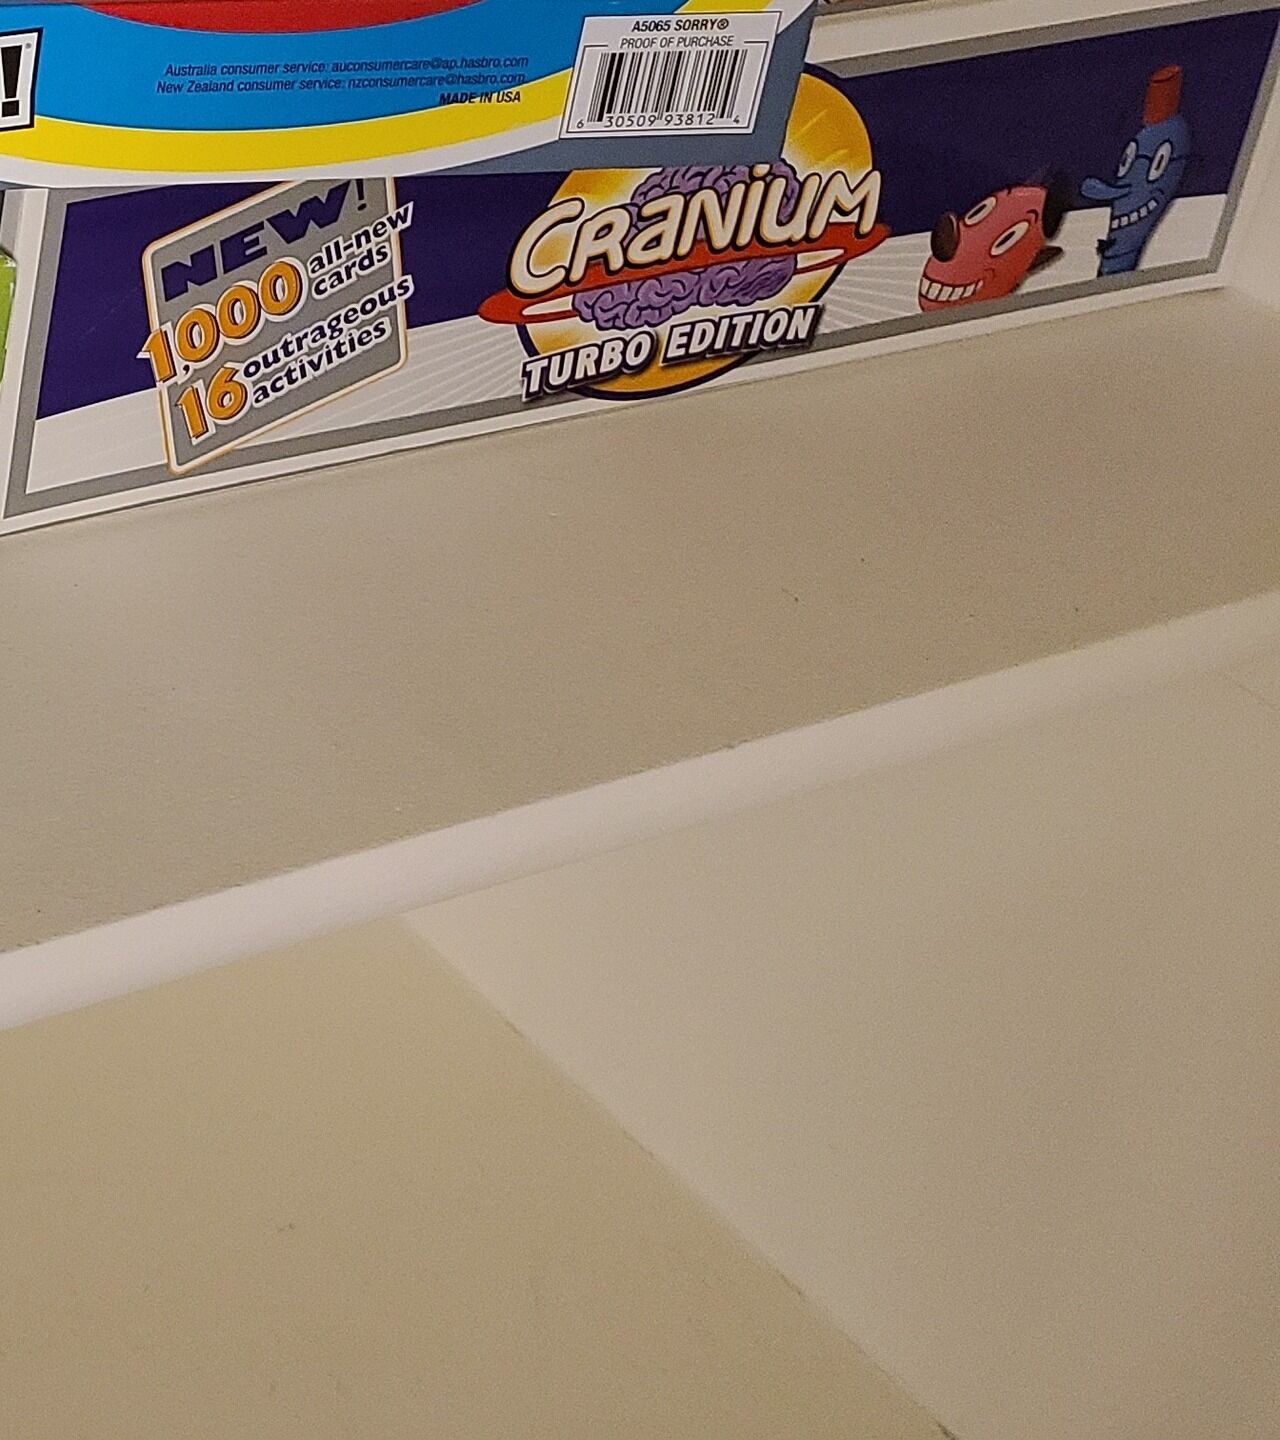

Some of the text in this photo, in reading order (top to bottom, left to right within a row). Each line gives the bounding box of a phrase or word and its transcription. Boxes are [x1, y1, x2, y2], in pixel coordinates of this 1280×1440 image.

[619, 34, 735, 50] PROOF OF PURCHASE
[630, 18, 672, 33] A5065
[155, 71, 526, 95] New Zealand consumer service: nzconsumercare@hasbro.com
[164, 55, 530, 78] Australia consumer service: auconsumercare@ap.hasbro.com
[438, 90, 523, 106] MADE IN USA
[576, 112, 741, 130] 6 30509 93812 4
[160, 177, 367, 304] NEW!
[308, 203, 411, 278] all-new
[312, 244, 390, 297] cards
[140, 259, 303, 384] 1,000
[242, 278, 411, 379] outrageous
[521, 302, 821, 400] TURBO EDITION
[252, 319, 387, 405] activities
[176, 363, 249, 441] 16
